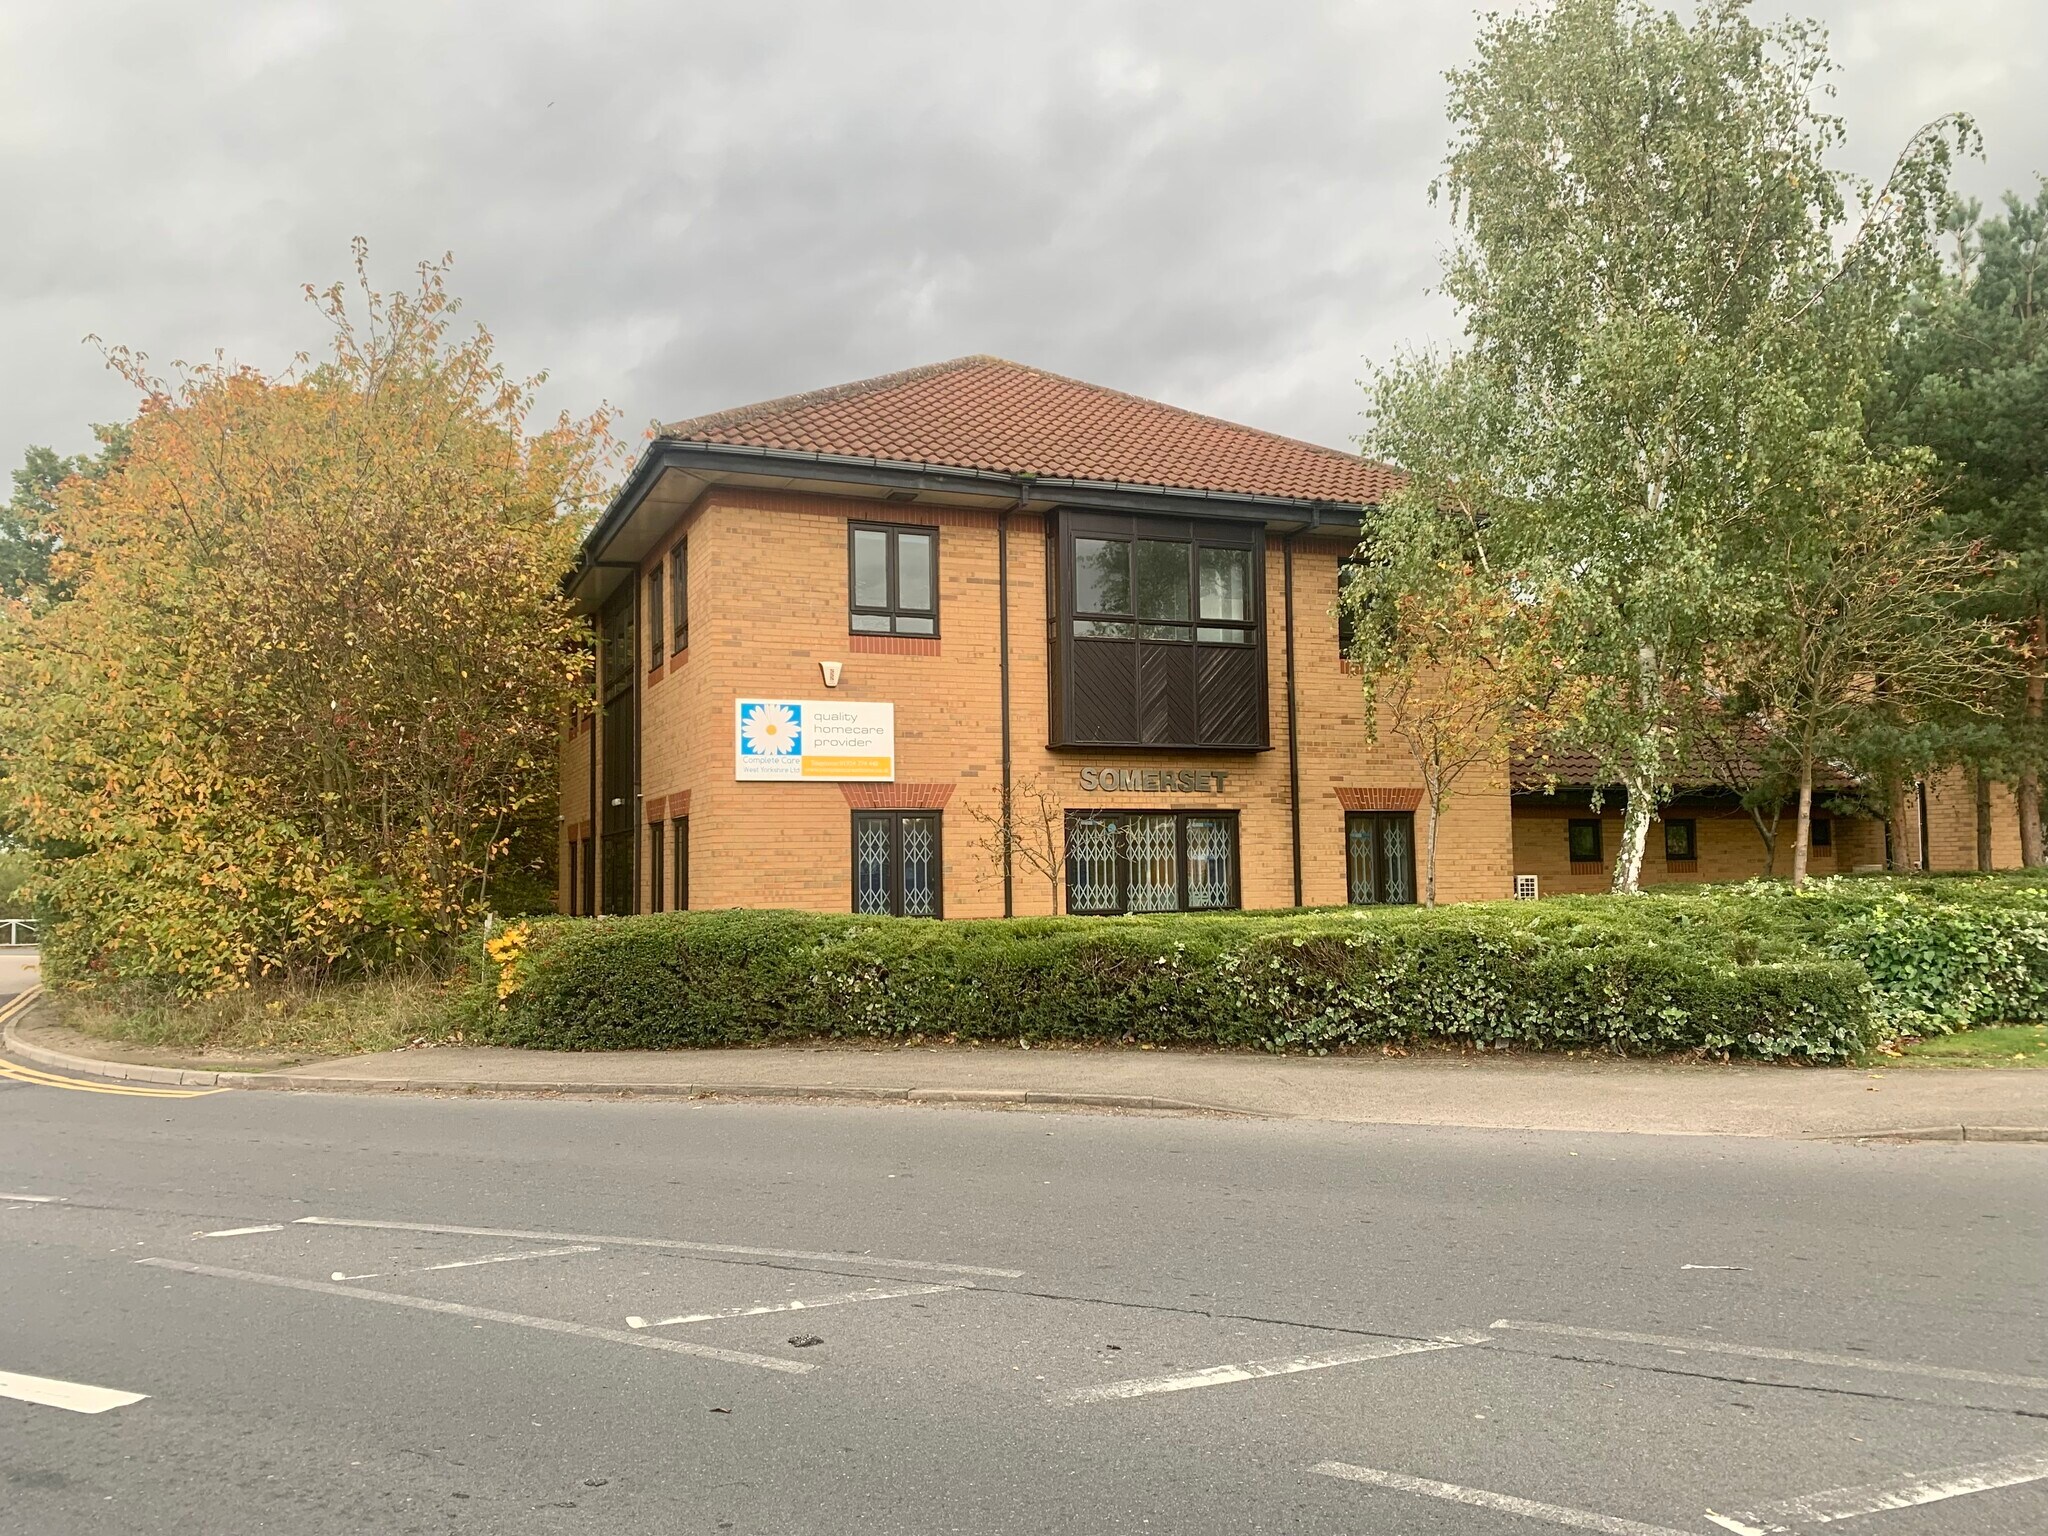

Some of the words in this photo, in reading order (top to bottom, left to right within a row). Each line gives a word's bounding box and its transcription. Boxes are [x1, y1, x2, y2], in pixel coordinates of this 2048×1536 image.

[814, 712, 858, 723] quality
[814, 725, 884, 735] homecare
[814, 738, 872, 748] provider
[743, 756, 780, 766] Complete
[781, 757, 800, 765] Care
[1080, 766, 1229, 793] SOMERSET
